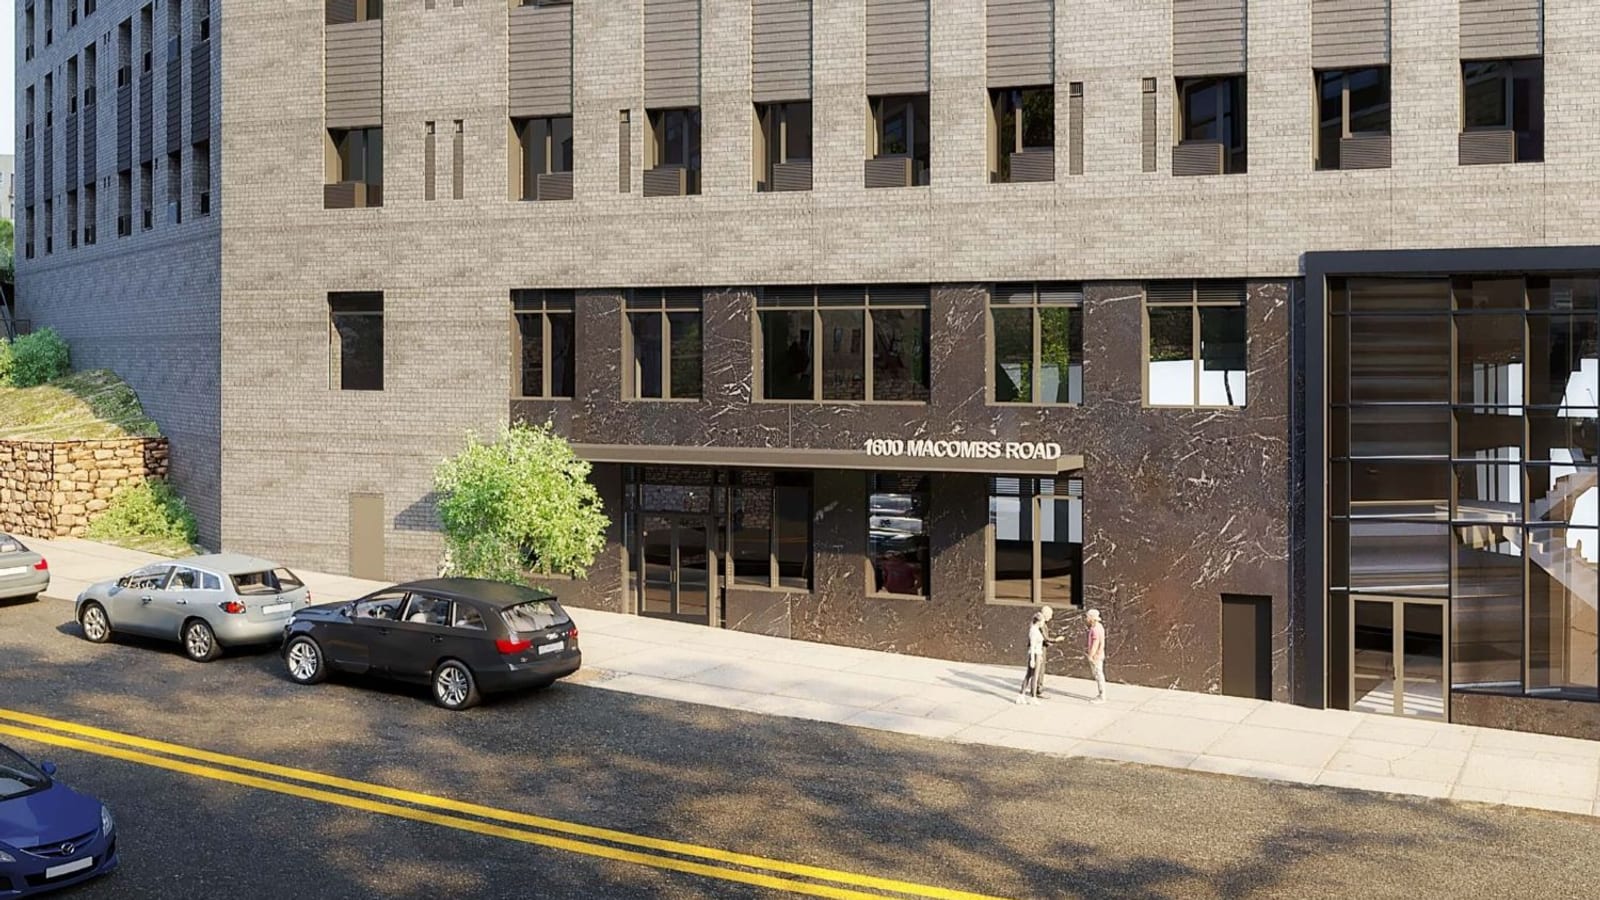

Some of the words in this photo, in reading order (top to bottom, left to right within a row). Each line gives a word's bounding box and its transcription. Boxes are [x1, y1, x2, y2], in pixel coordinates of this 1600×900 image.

[864, 439, 904, 456] 1600
[907, 440, 1001, 458] MACOMBS
[1006, 442, 1061, 460] ROAD
